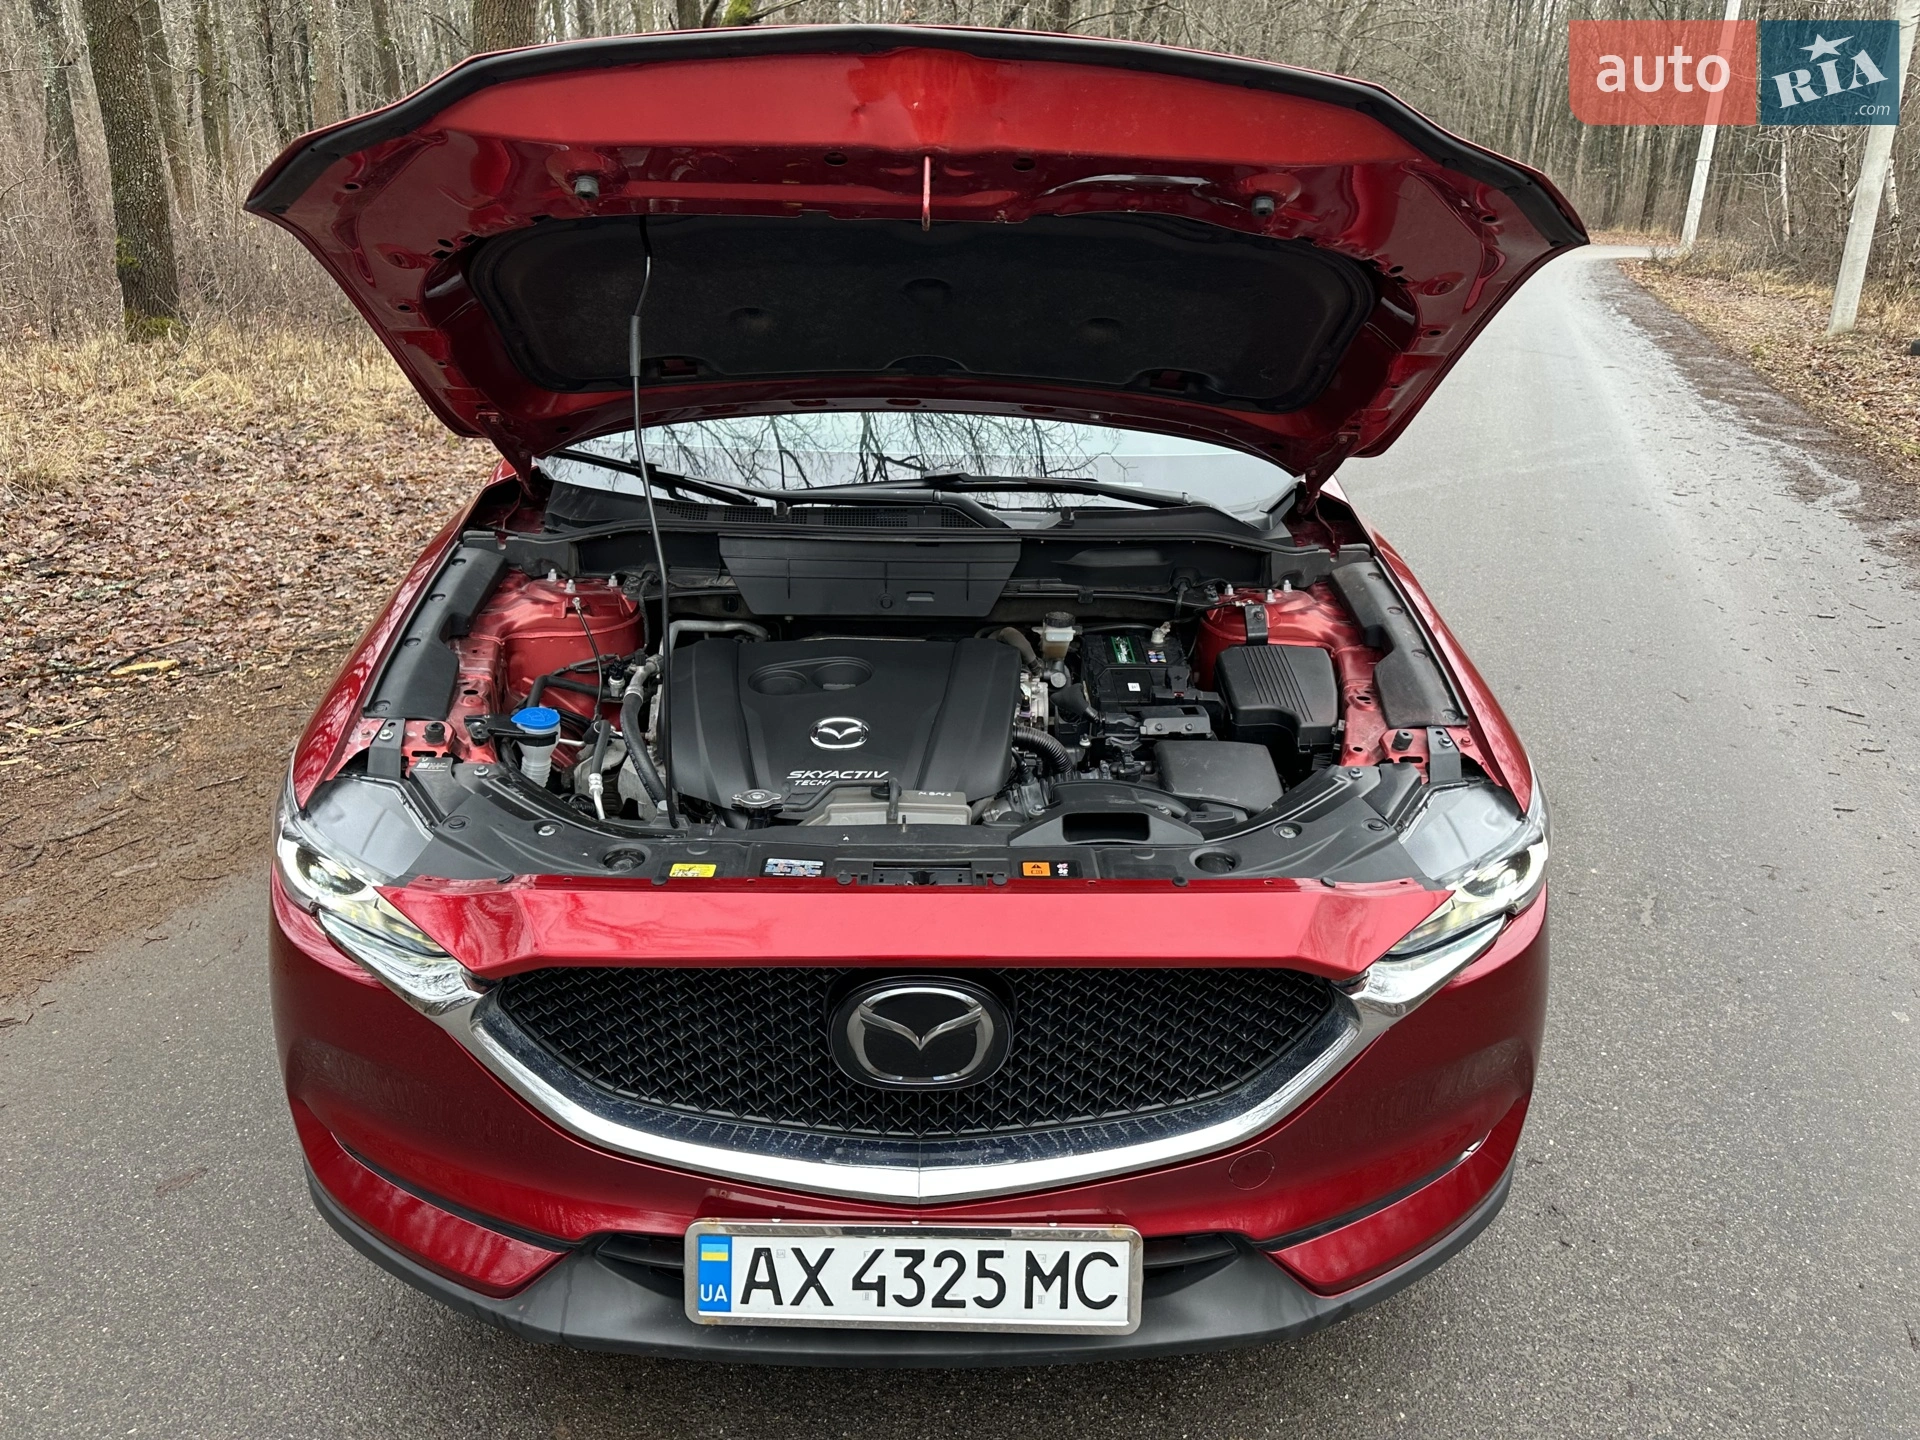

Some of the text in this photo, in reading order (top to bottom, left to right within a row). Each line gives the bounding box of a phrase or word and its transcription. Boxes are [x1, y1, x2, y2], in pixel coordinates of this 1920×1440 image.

[786, 770, 890, 780] SKYACTIV
[739, 1247, 1119, 1311] AX 4325 MC
[699, 1284, 728, 1303] UA
